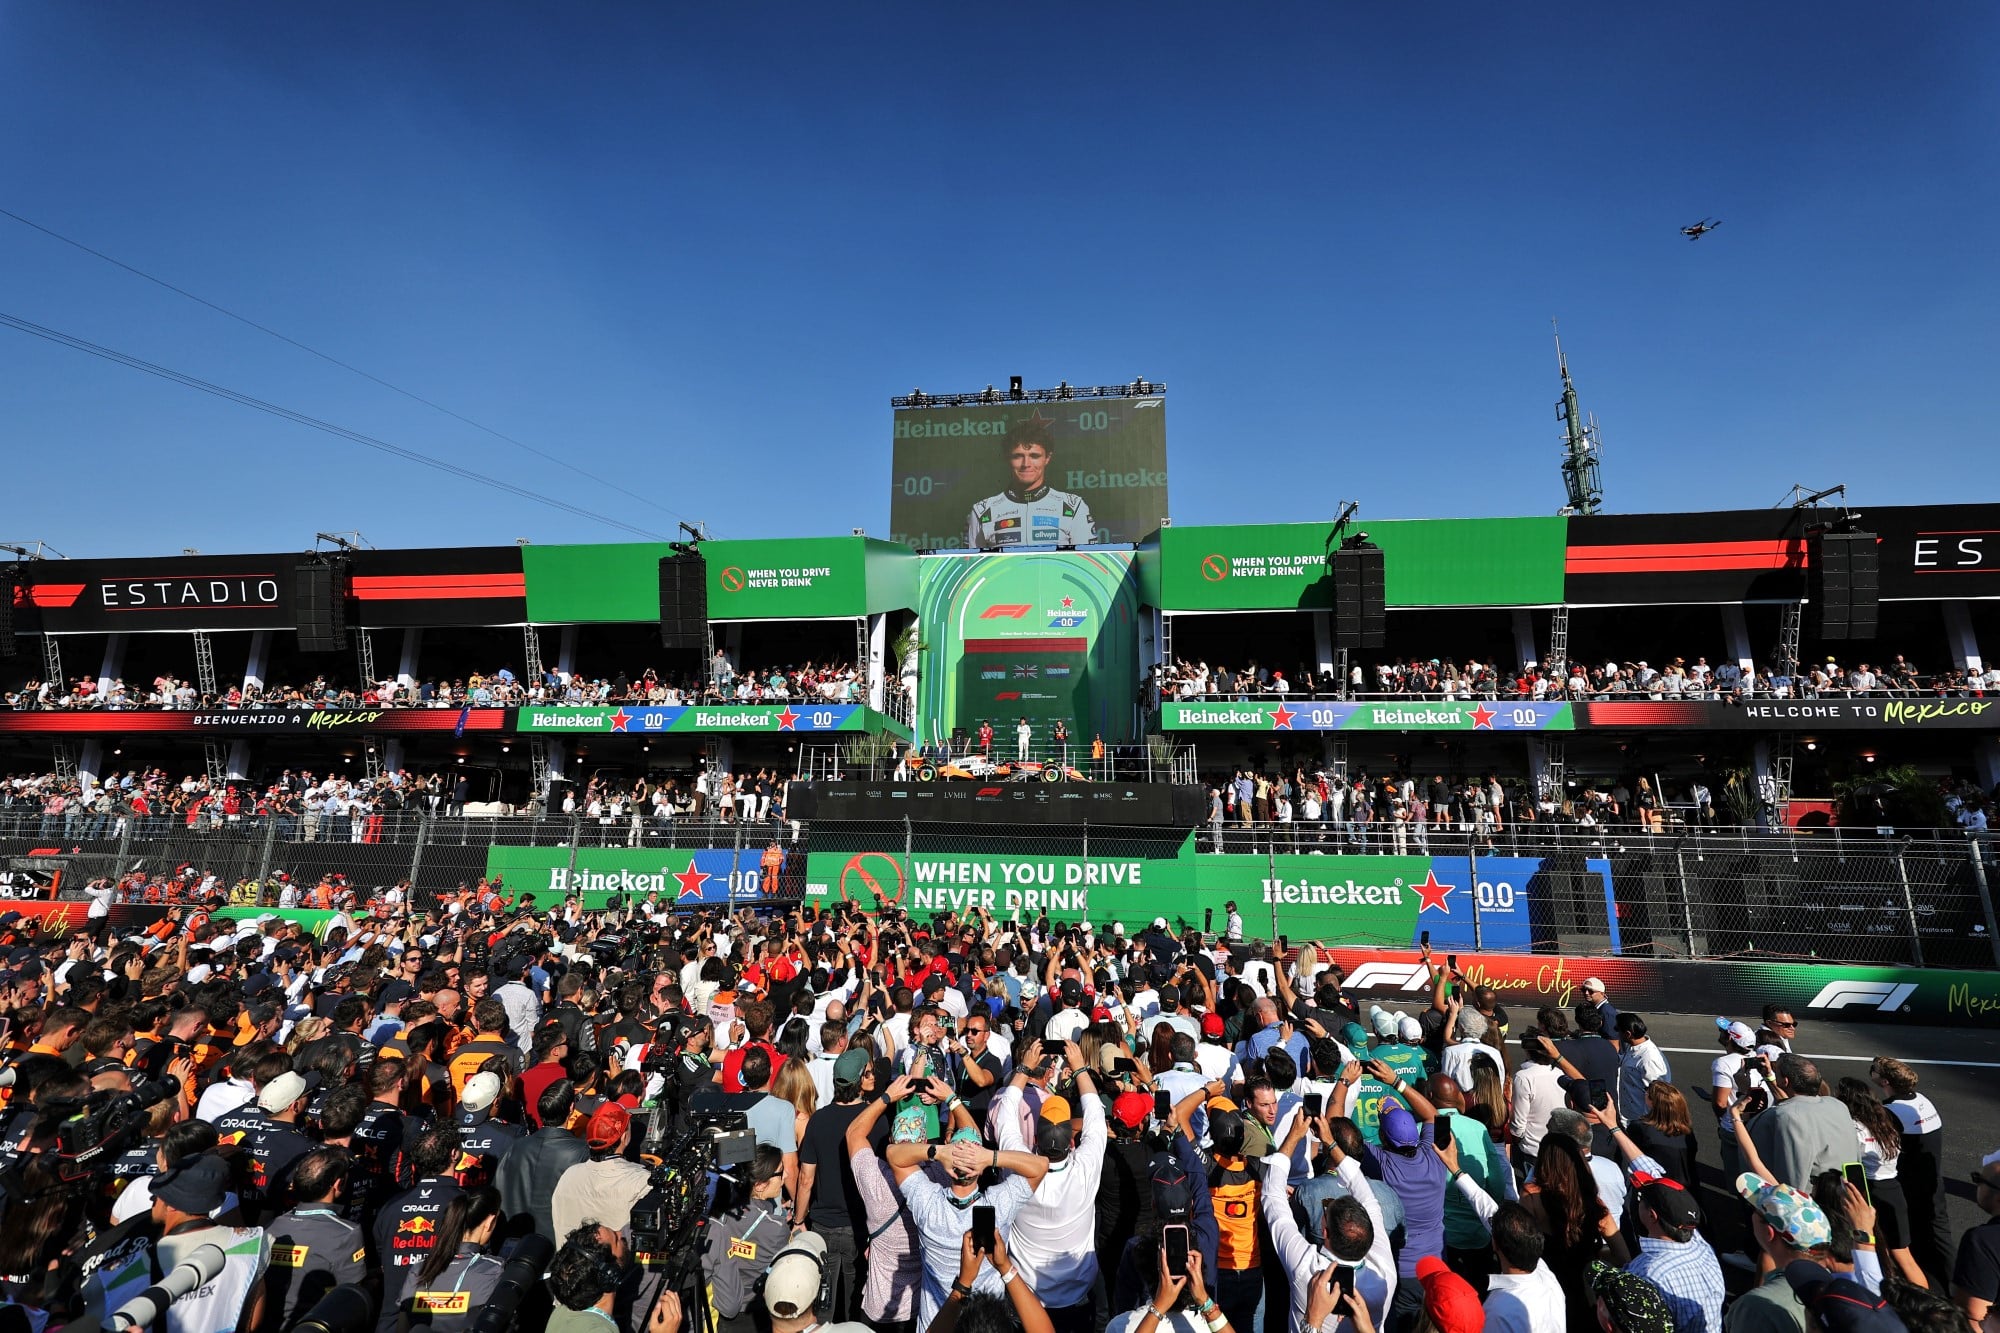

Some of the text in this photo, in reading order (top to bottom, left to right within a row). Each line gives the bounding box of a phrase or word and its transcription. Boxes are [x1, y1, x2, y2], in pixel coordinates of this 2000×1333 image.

[894, 416, 1007, 439] Heineken
[1035, 531, 1057, 540] allwyn
[1232, 555, 1326, 566] WHEN YOU DRIVE
[1914, 539, 1983, 566] ES
[747, 567, 831, 578] WHEN YOU DRIVE
[1232, 566, 1304, 577] NEVER DRINK
[748, 577, 812, 588] NEVER DRINK
[102, 580, 279, 605] ESTADIO
[1047, 609, 1088, 617] Heineken
[193, 710, 384, 731] BIENVENIDO A Mexico
[532, 713, 603, 727] Heineken
[695, 712, 769, 726] Heineken
[1178, 709, 1262, 724] Heineken
[1372, 709, 1461, 724] Heineken
[1746, 701, 1992, 724] WELCOME TO Mexico
[944, 791, 967, 799] LVMH
[549, 867, 665, 892] Heineken
[914, 862, 1141, 885] WHEN YOU DRIVE
[914, 888, 1088, 911] NEVER DRINK
[1261, 879, 1513, 907] Heineken 0.0
[43, 904, 71, 939] City
[1465, 958, 1576, 1008] Mexico City
[1355, 1098, 1380, 1128] 18
[76, 1147, 104, 1163] RONIN
[393, 1235, 437, 1249] Red Bull
[82, 1237, 130, 1277] Road
[417, 1296, 464, 1309] PIRELLI
